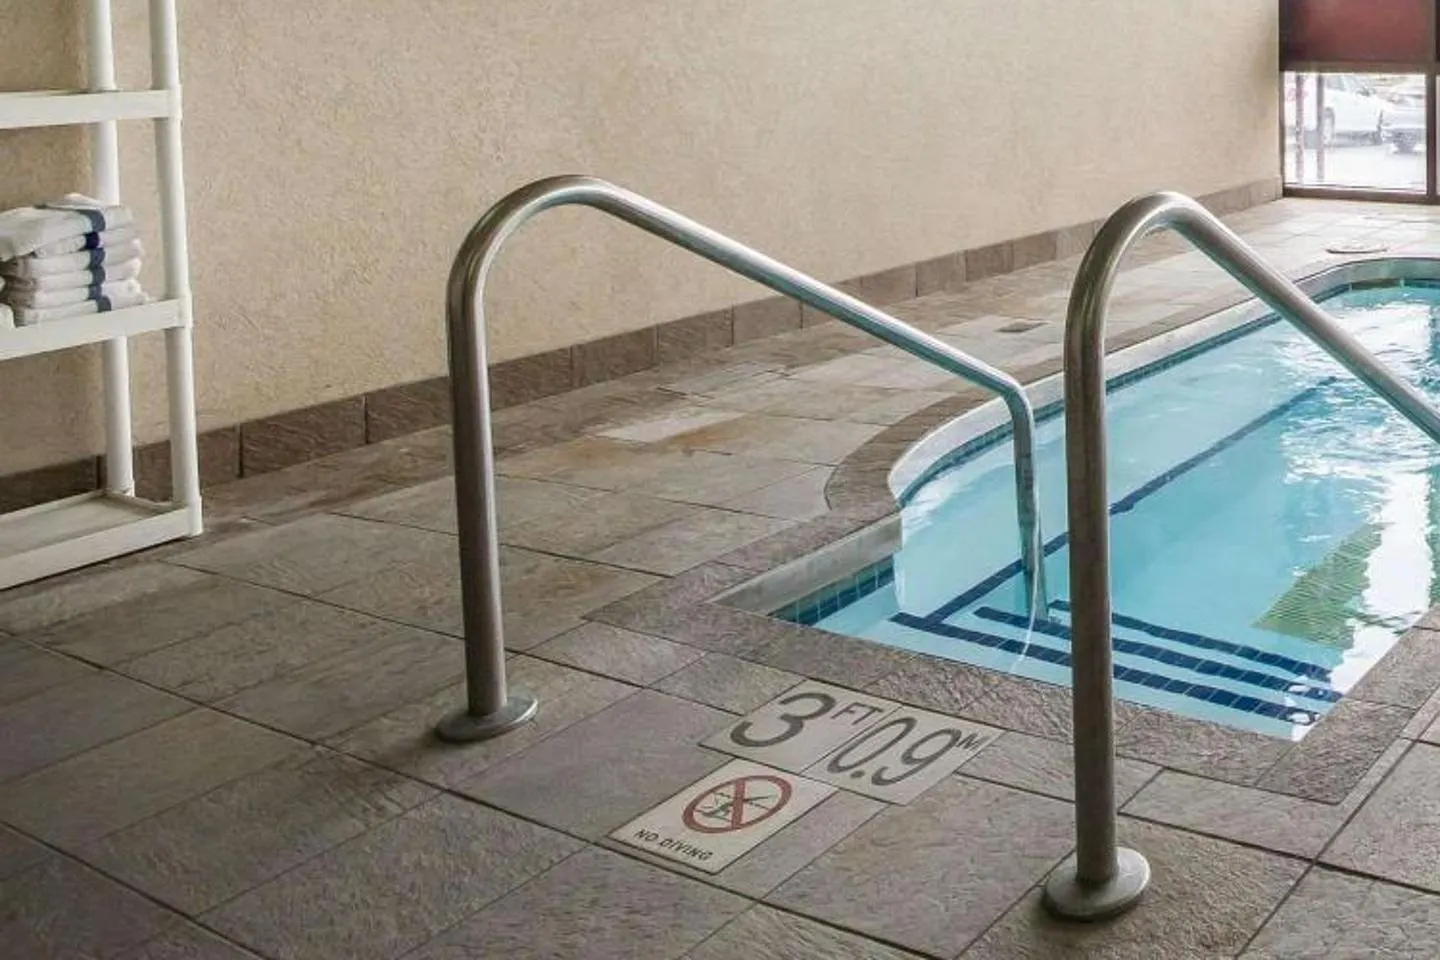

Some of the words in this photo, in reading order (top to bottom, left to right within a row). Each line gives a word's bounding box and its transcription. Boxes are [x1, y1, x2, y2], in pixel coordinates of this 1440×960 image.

[731, 692, 836, 747] 3
[830, 701, 883, 725] FT
[827, 716, 962, 786] 0.9
[634, 828, 659, 841] NO
[659, 838, 713, 860] DIVING
